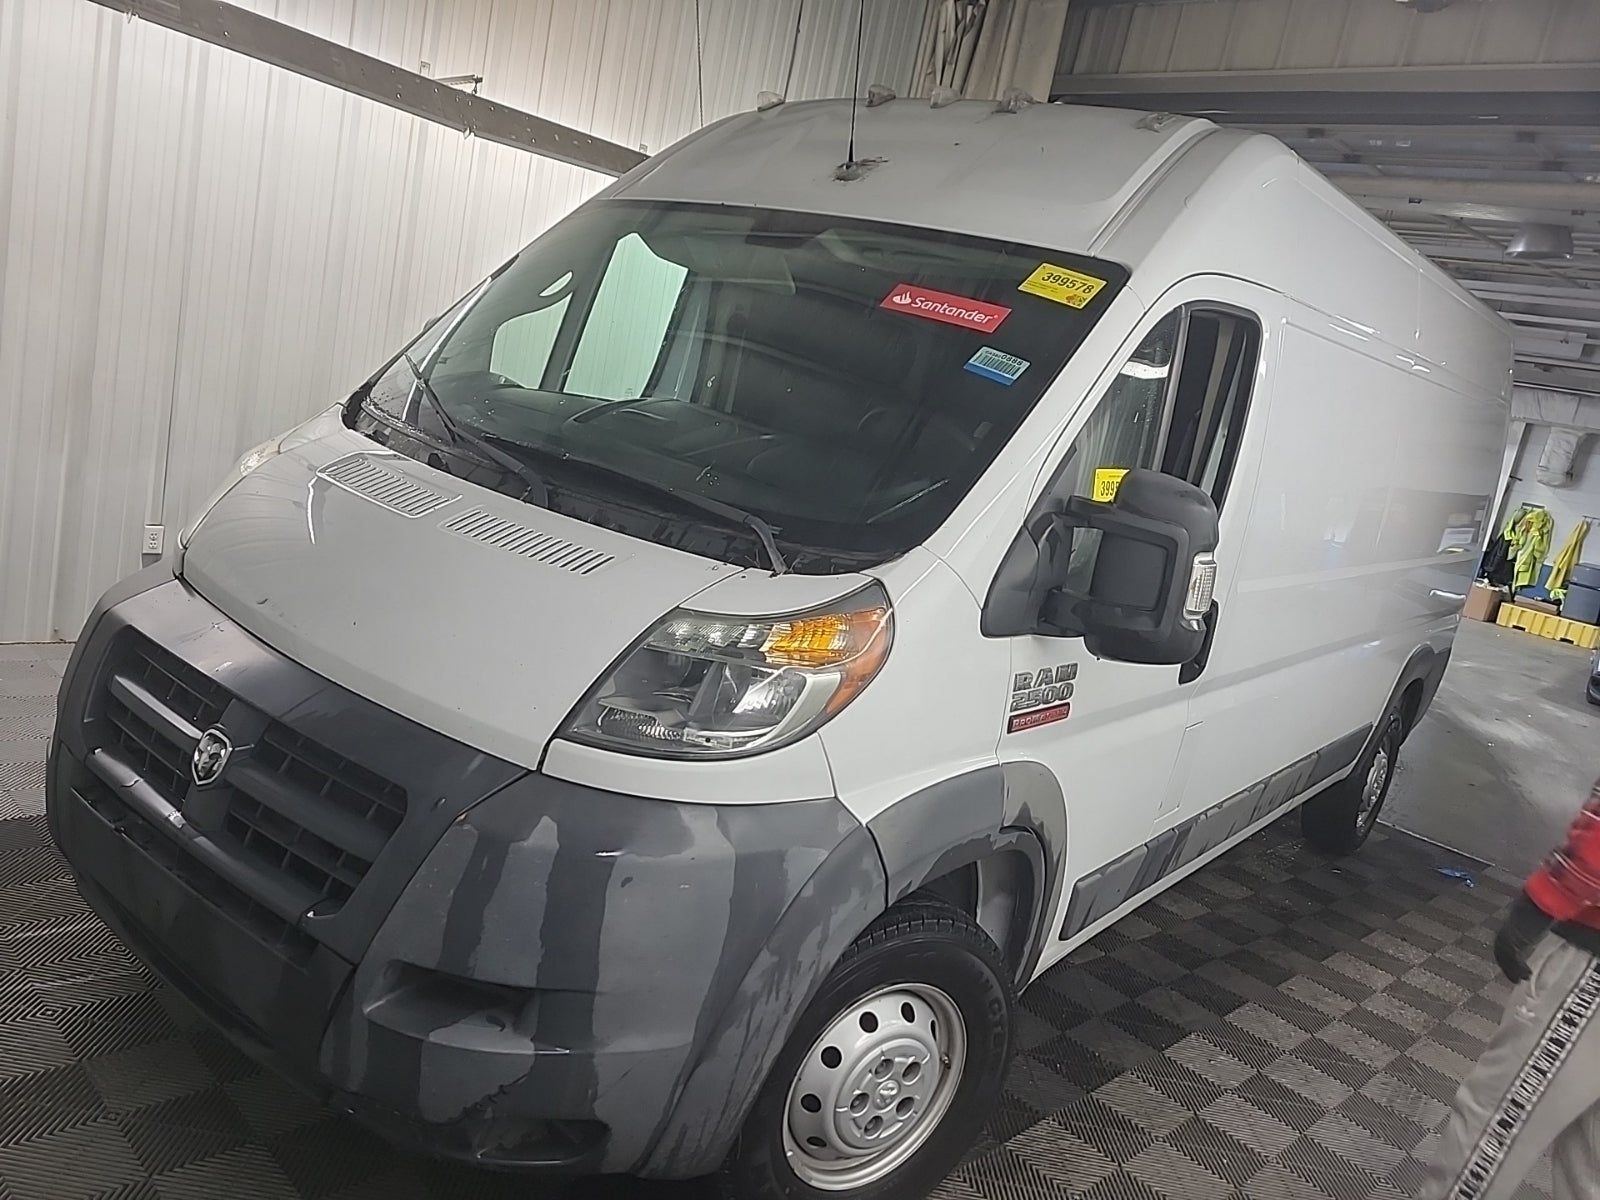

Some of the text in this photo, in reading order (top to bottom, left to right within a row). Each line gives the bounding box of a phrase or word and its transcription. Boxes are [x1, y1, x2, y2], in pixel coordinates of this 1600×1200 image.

[1041, 272, 1095, 294] 399578
[911, 297, 993, 324] Santander
[1101, 480, 1120, 496] 399
[1013, 662, 1078, 692] RAM
[1010, 682, 1074, 713] 2500
[1533, 1041, 1562, 1072] WITH
[1552, 1022, 1575, 1043] THE
[1564, 1011, 1580, 1023] 3
